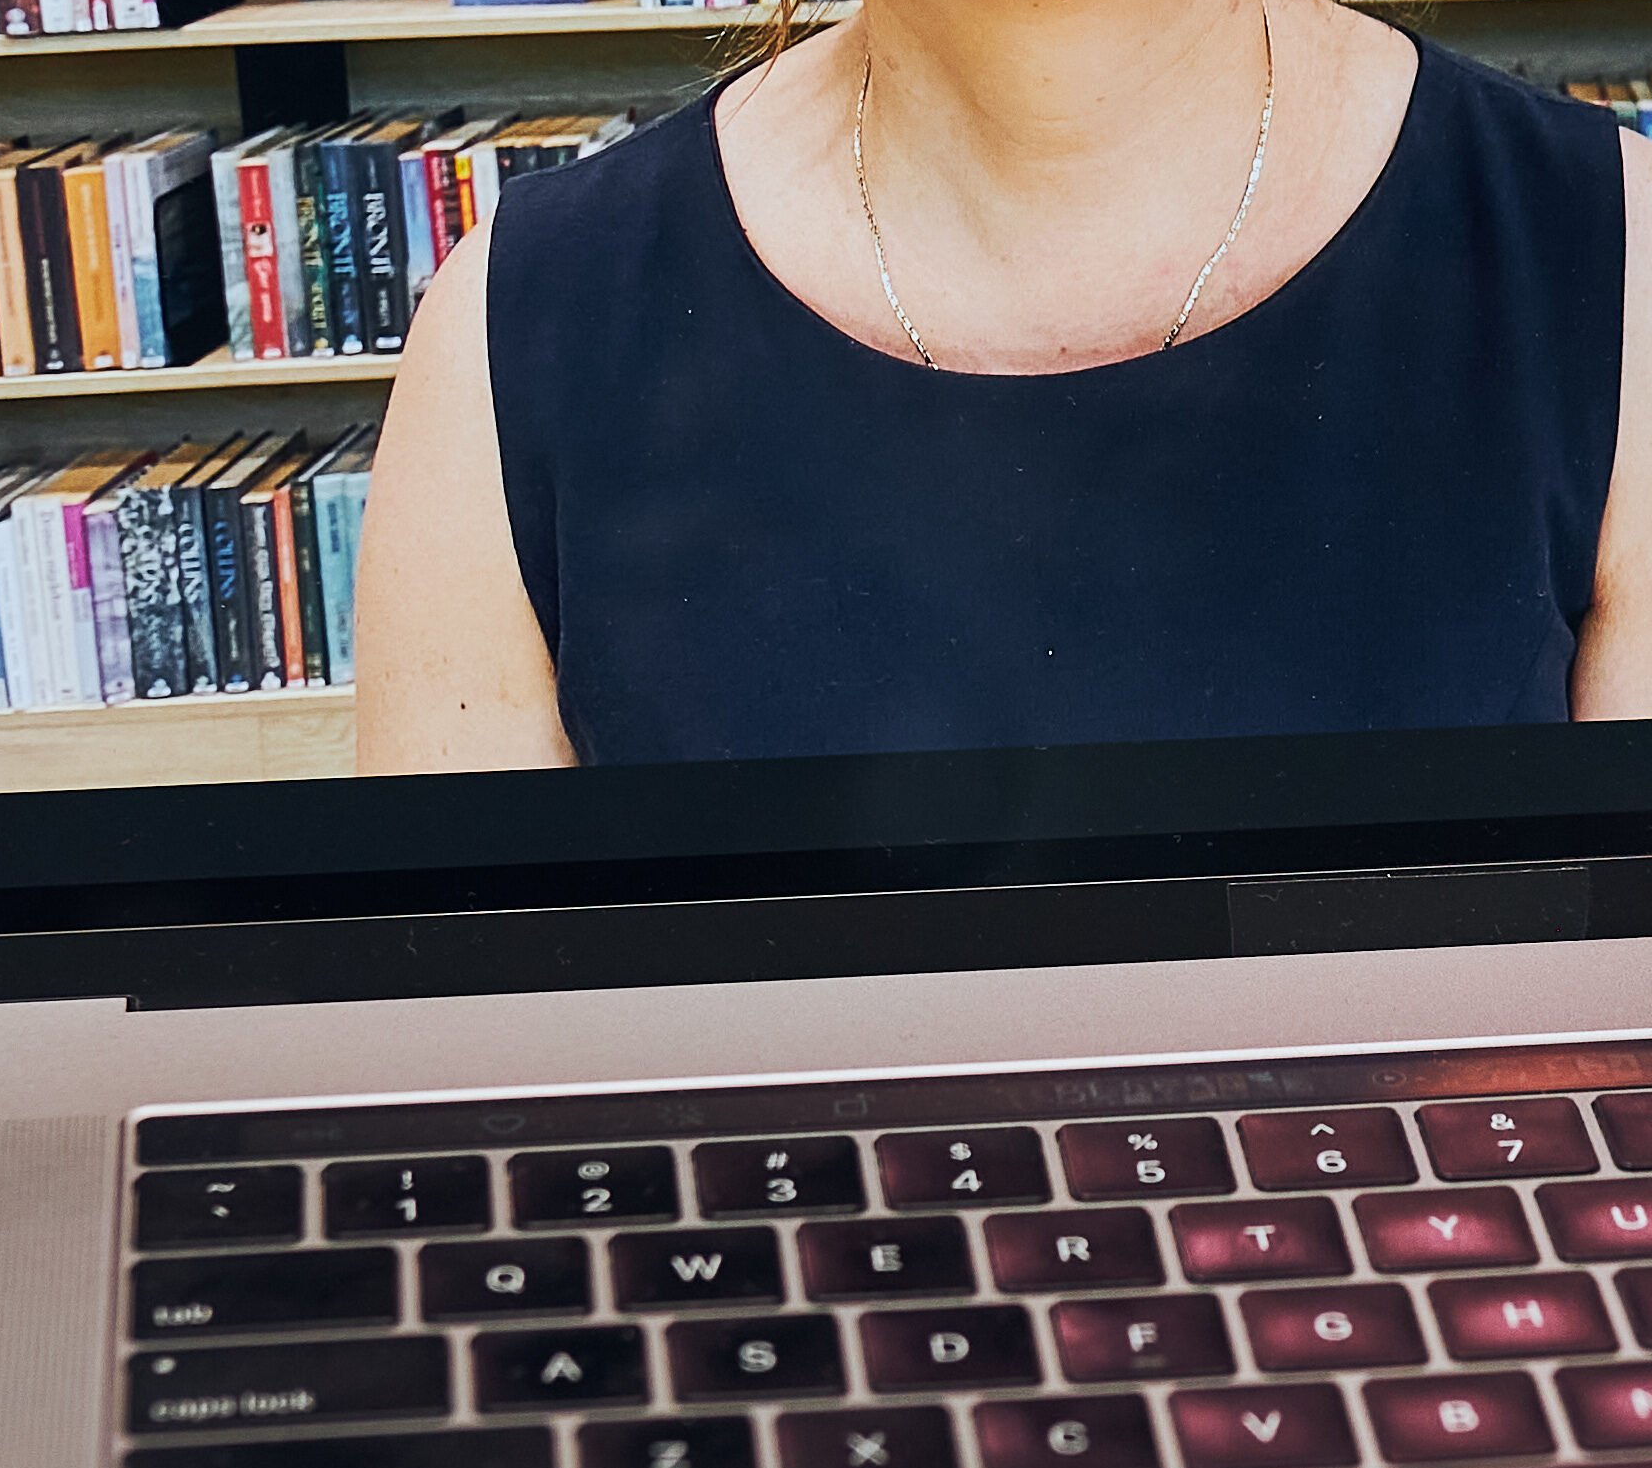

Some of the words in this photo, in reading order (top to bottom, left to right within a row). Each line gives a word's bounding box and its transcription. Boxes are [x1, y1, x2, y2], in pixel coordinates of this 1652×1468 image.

[1490, 1113, 1516, 1131] &
[949, 1142, 972, 1161] $
[1127, 1133, 1158, 1151] %
[1497, 1139, 1524, 1162] 7
[577, 1161, 610, 1179] @
[766, 1152, 788, 1169] #
[1136, 1159, 1166, 1184] 5
[1316, 1149, 1347, 1173] 6
[768, 1178, 798, 1202] 3
[951, 1169, 982, 1192] 4
[398, 1198, 417, 1221] 1
[582, 1188, 612, 1213] 2
[1427, 1214, 1459, 1242] Y
[1610, 1204, 1650, 1231] U
[1056, 1236, 1090, 1262] R
[1243, 1224, 1276, 1252] T
[671, 1254, 722, 1282] W
[870, 1244, 900, 1272] E
[485, 1265, 526, 1293] Q
[1313, 1311, 1353, 1341] G
[1502, 1300, 1545, 1330] H
[929, 1333, 970, 1363] D
[1127, 1322, 1156, 1352] F
[543, 1353, 582, 1382] A
[739, 1341, 777, 1372] S
[1242, 1411, 1281, 1443] V
[1438, 1400, 1480, 1433] B
[849, 1434, 886, 1464] X
